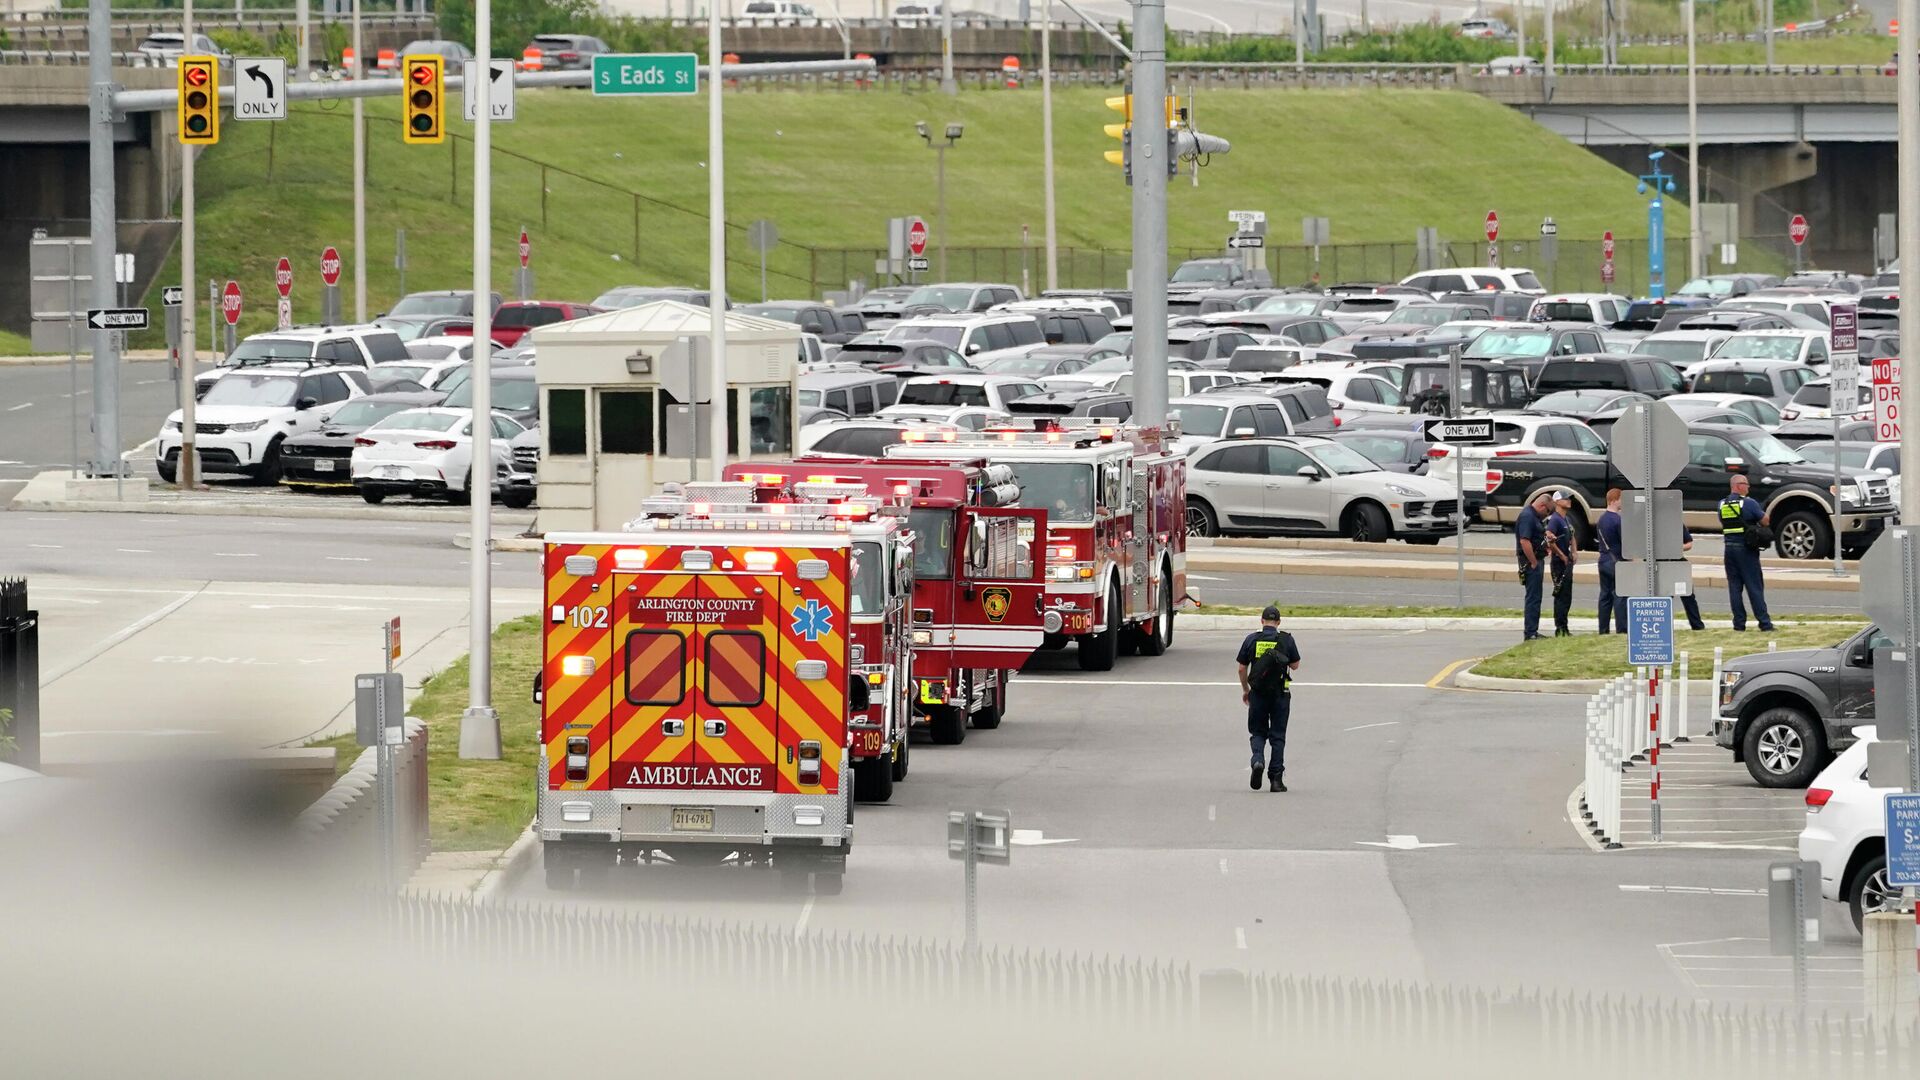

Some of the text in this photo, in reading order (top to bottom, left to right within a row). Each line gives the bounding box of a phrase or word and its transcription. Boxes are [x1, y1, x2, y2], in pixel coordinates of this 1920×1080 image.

[601, 65, 688, 85] S Eads St
[242, 102, 278, 114] ONLY
[322, 259, 339, 274] STOP
[277, 270, 291, 285] STOP
[224, 295, 240, 311] STOP
[105, 314, 141, 323] ONE WAY
[1873, 363, 1890, 380] NO
[1445, 425, 1486, 435] ONE WAY
[637, 598, 756, 611] ARLINGTON COUNTY
[568, 606, 608, 629] 102
[665, 611, 727, 623] FIRE DEPT
[1071, 615, 1087, 629] 101
[1641, 623, 1660, 634] S-C
[863, 732, 880, 750] 109
[626, 766, 762, 786] AMBULANCE
